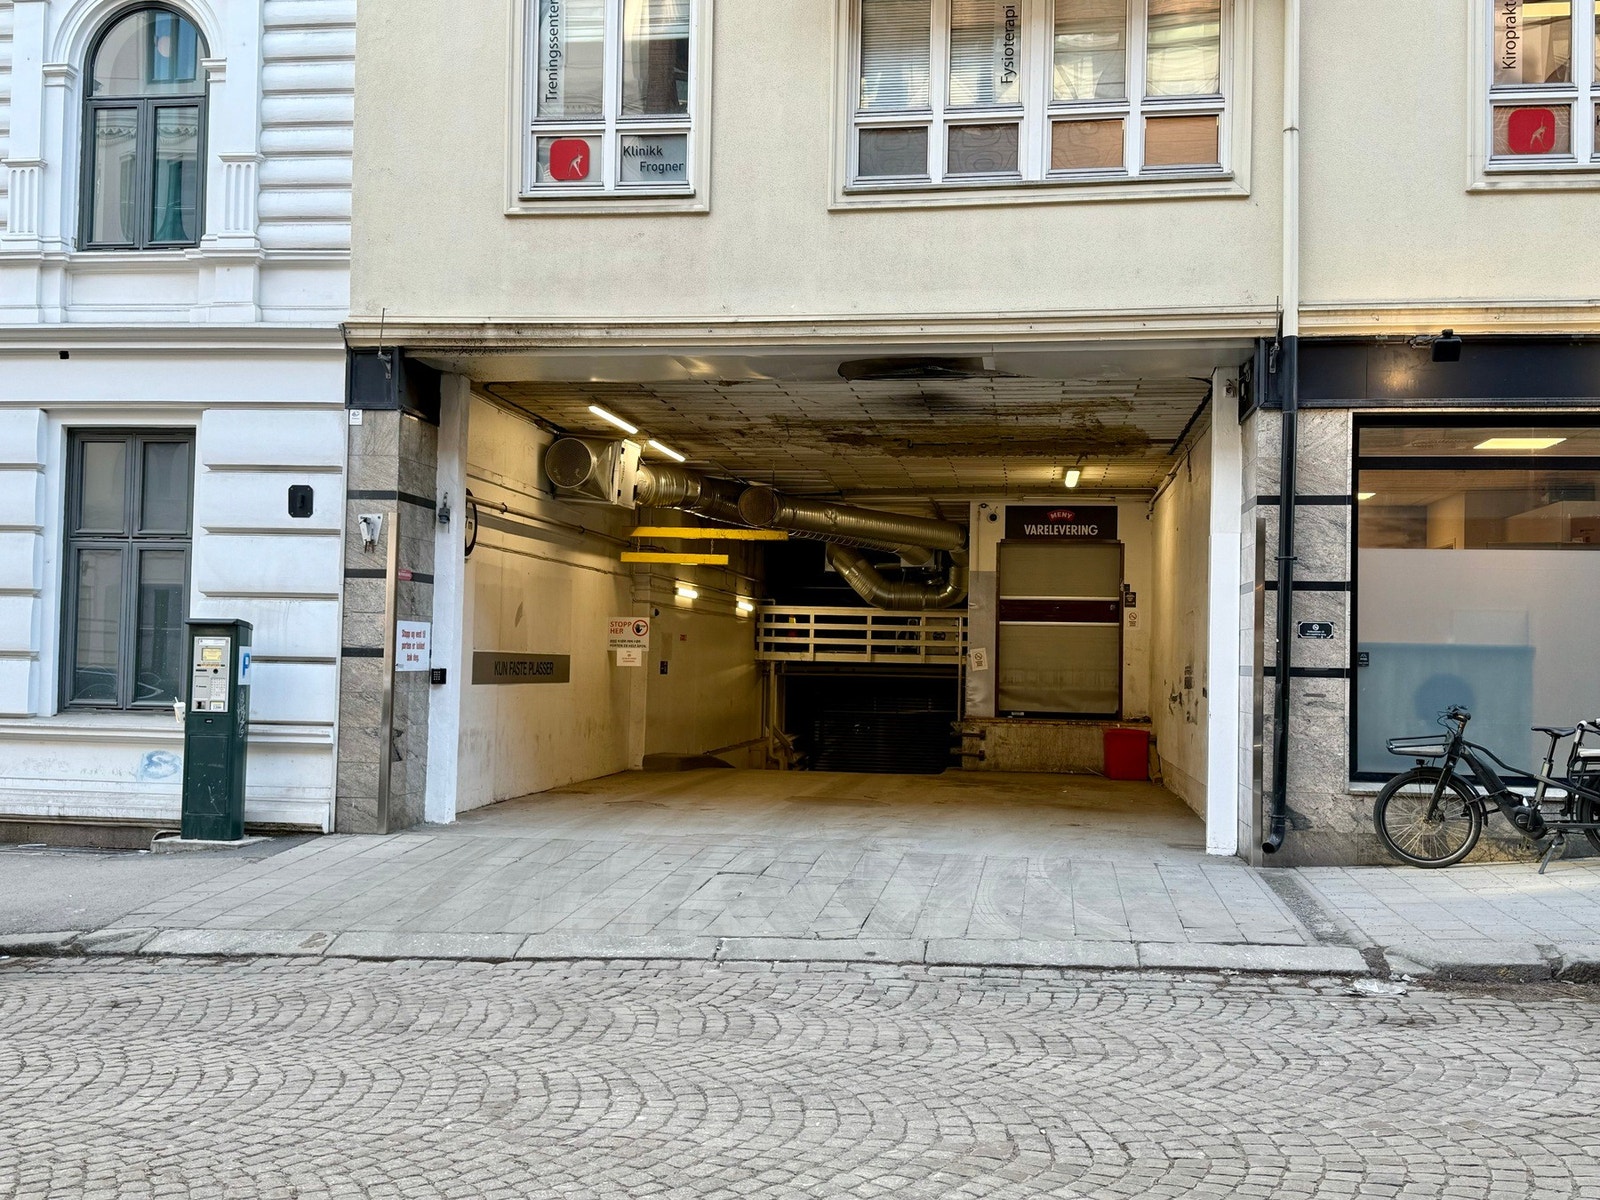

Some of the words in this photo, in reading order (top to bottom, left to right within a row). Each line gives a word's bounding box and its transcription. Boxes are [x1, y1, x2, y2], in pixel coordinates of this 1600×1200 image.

[545, 0, 562, 103] Treningssenter
[1000, 5, 1018, 85] Fysioterapi
[622, 145, 664, 158] Klinikk
[639, 160, 684, 176] Frogner
[1050, 510, 1073, 520] MENY
[1024, 524, 1098, 536] VARELEVERING
[494, 661, 508, 675] KUN
[509, 661, 527, 675] FASTE
[529, 661, 554, 675] PLASSER
